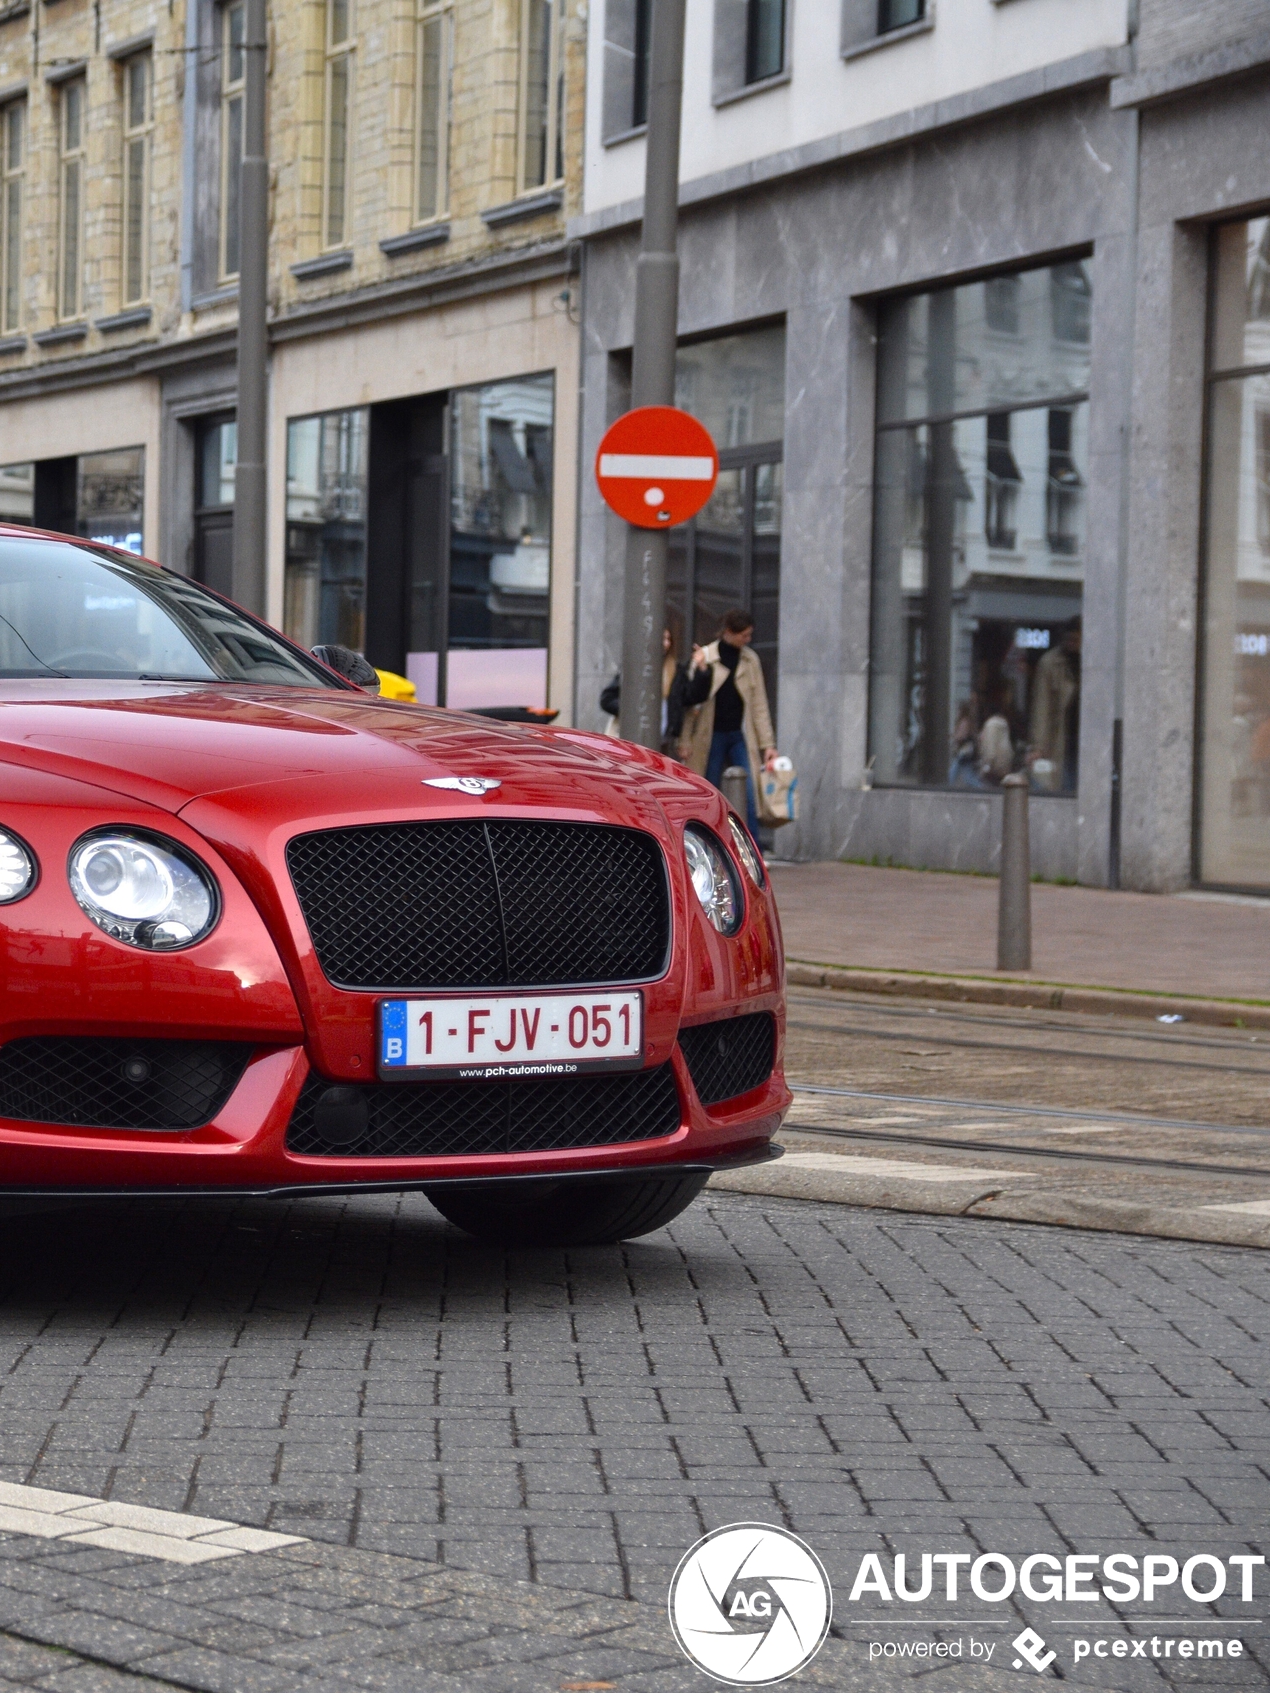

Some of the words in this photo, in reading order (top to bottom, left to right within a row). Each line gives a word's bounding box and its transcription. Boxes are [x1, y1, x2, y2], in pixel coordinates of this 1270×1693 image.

[419, 1004, 630, 1054] 1-FJV-051
[387, 1038, 402, 1058] B
[460, 1064, 577, 1077] www.pch-automotive.be
